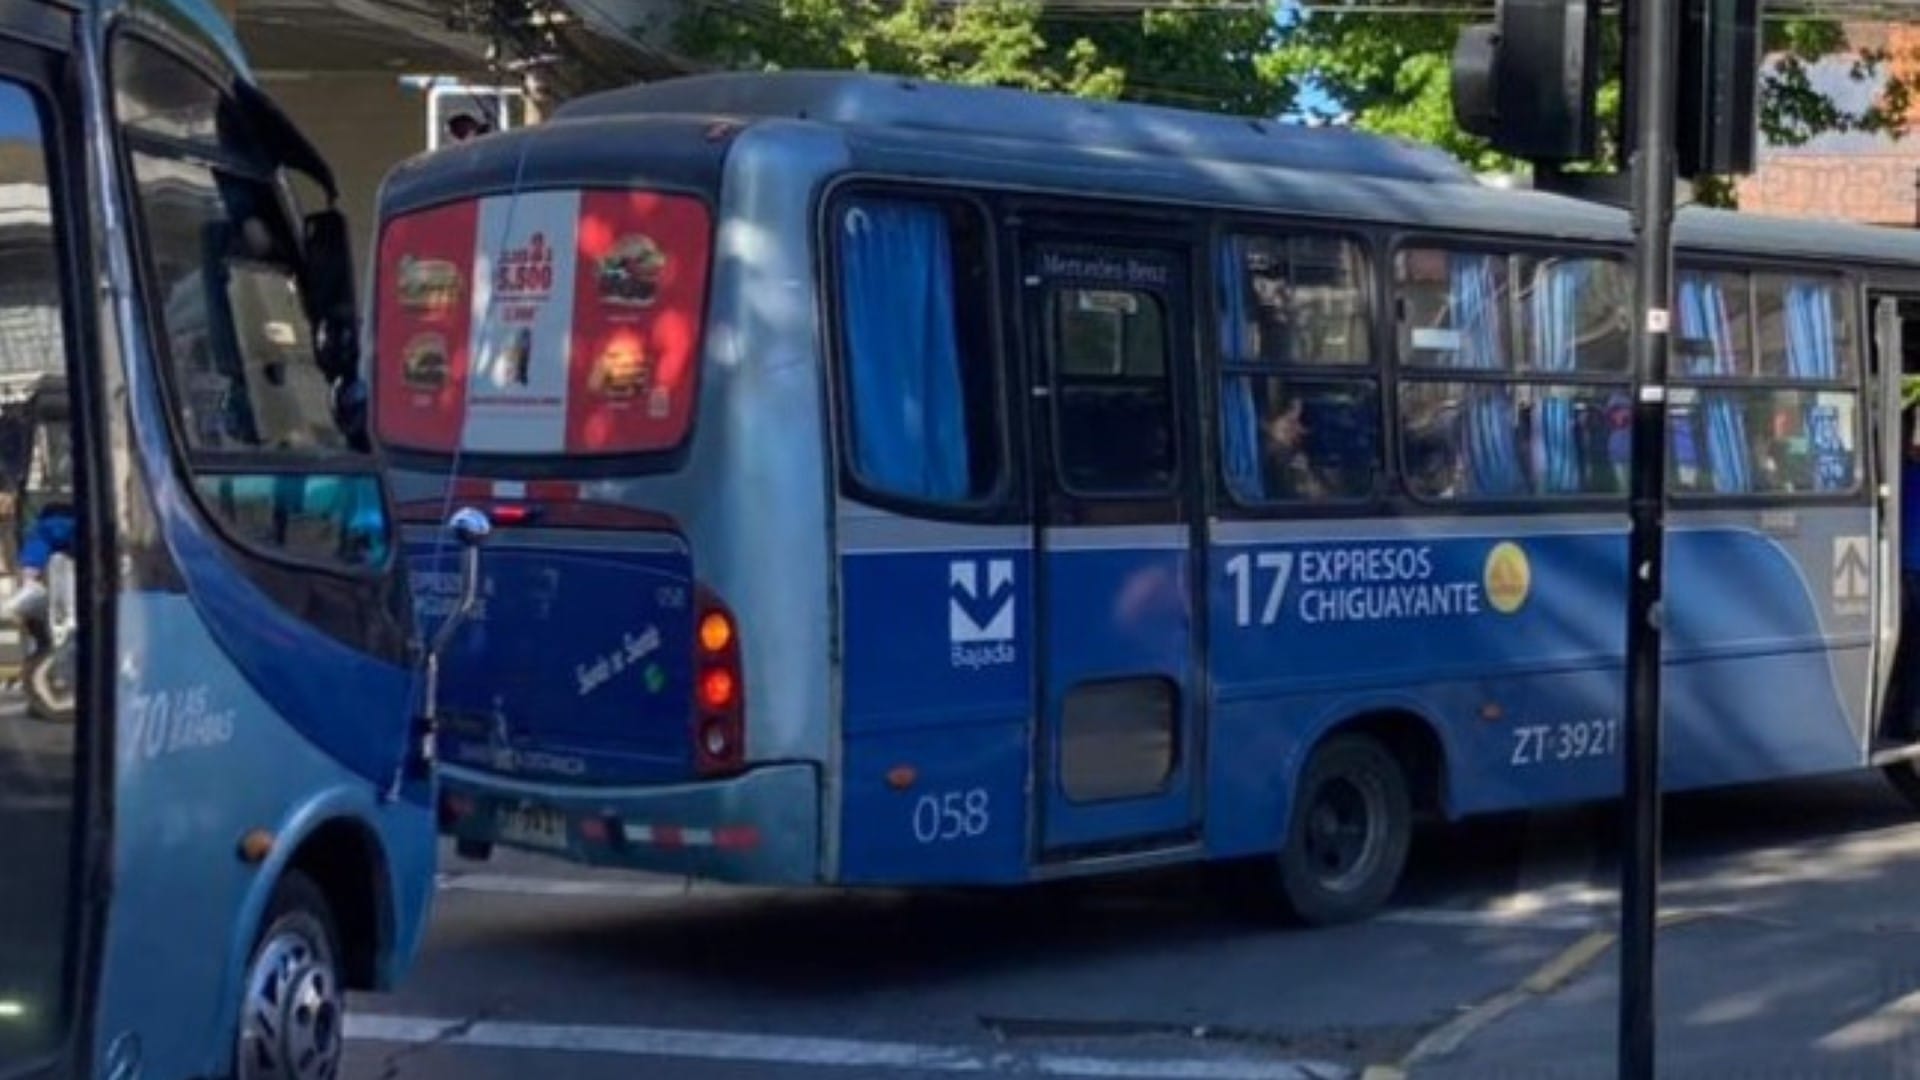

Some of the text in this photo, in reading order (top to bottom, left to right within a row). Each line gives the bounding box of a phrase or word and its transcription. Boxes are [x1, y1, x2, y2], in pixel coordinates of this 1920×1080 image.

[1301, 548, 1432, 583] EXPRESOS
[1225, 551, 1294, 627] 17
[1300, 583, 1480, 624] CHIGUAYANTE
[951, 643, 1016, 671] Bajada
[913, 788, 989, 843] 058
